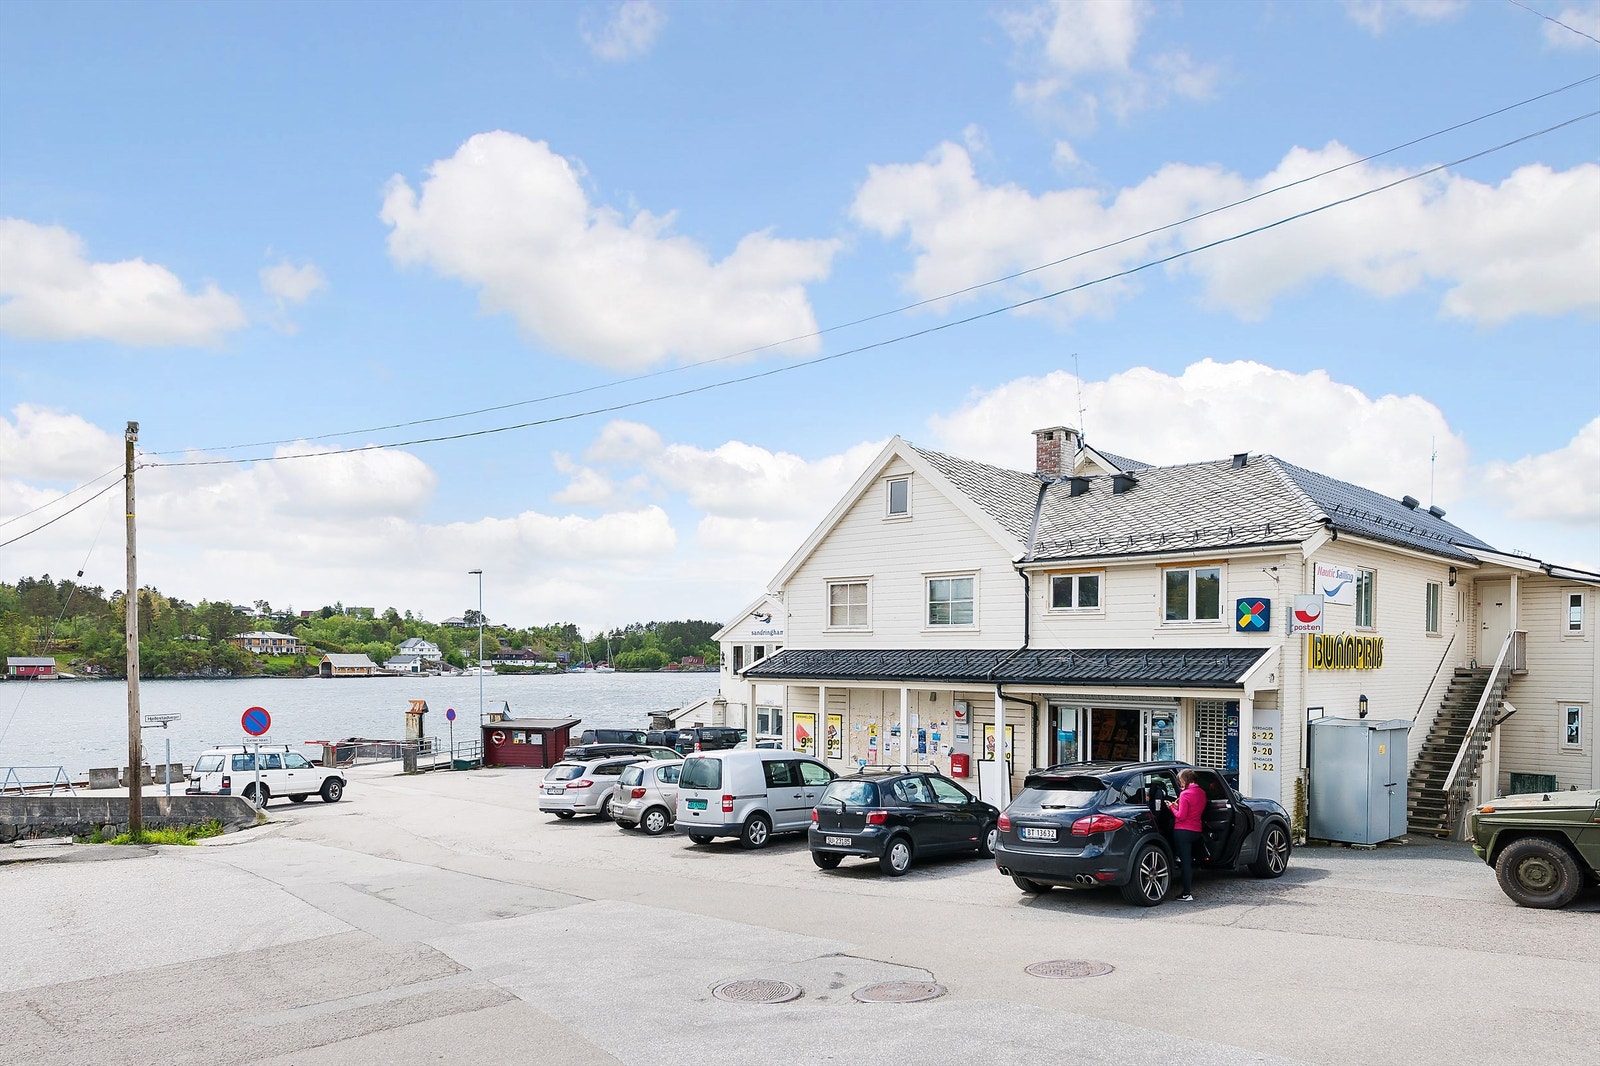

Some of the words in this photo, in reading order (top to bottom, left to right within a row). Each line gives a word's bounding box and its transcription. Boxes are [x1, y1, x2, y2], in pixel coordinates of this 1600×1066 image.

[1317, 566, 1336, 579] Nautic
[1336, 569, 1354, 583] Sailing
[1293, 624, 1321, 632] posten
[1027, 828, 1035, 836] BT
[1036, 829, 1055, 838] 13632
